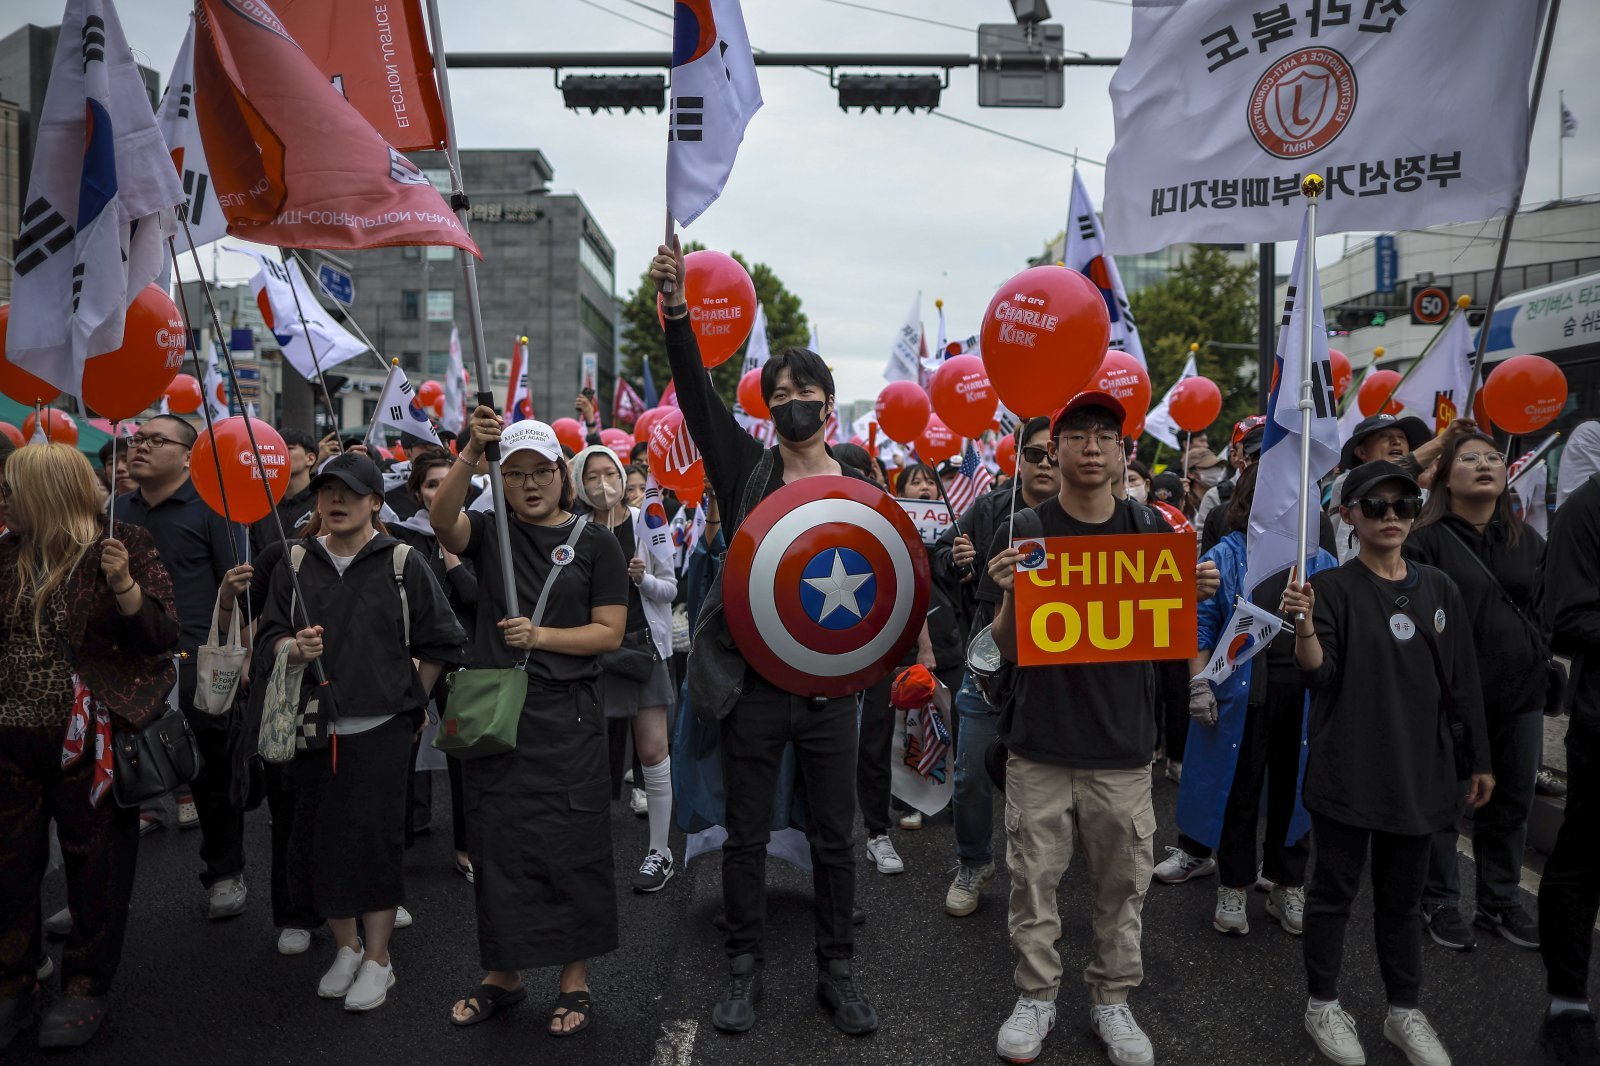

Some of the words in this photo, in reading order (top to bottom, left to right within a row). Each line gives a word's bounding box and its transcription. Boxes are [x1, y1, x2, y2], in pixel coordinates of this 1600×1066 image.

[702, 297, 713, 305] We
[714, 297, 728, 305] are
[1014, 293, 1026, 303] We
[1027, 296, 1045, 306] are
[1421, 299, 1442, 315] 50
[1526, 292, 1574, 320] 전기버스
[690, 305, 741, 321] CHARLIE
[994, 301, 1059, 331] CHARLIE
[701, 322, 732, 336] KIRK
[1563, 316, 1577, 337] 숨
[998, 322, 1038, 348] KIRK
[955, 378, 990, 394] CHARLIE
[1099, 375, 1139, 390] CHARLIE
[966, 391, 988, 403] KIRK
[1110, 387, 1133, 399] KIRK
[504, 430, 524, 442] MAKE
[525, 428, 550, 439] KOREA
[528, 435, 546, 443] AGAIN
[239, 449, 285, 465] CHARLIE
[1028, 549, 1183, 587] CHINA
[1030, 598, 1183, 652] OUT
